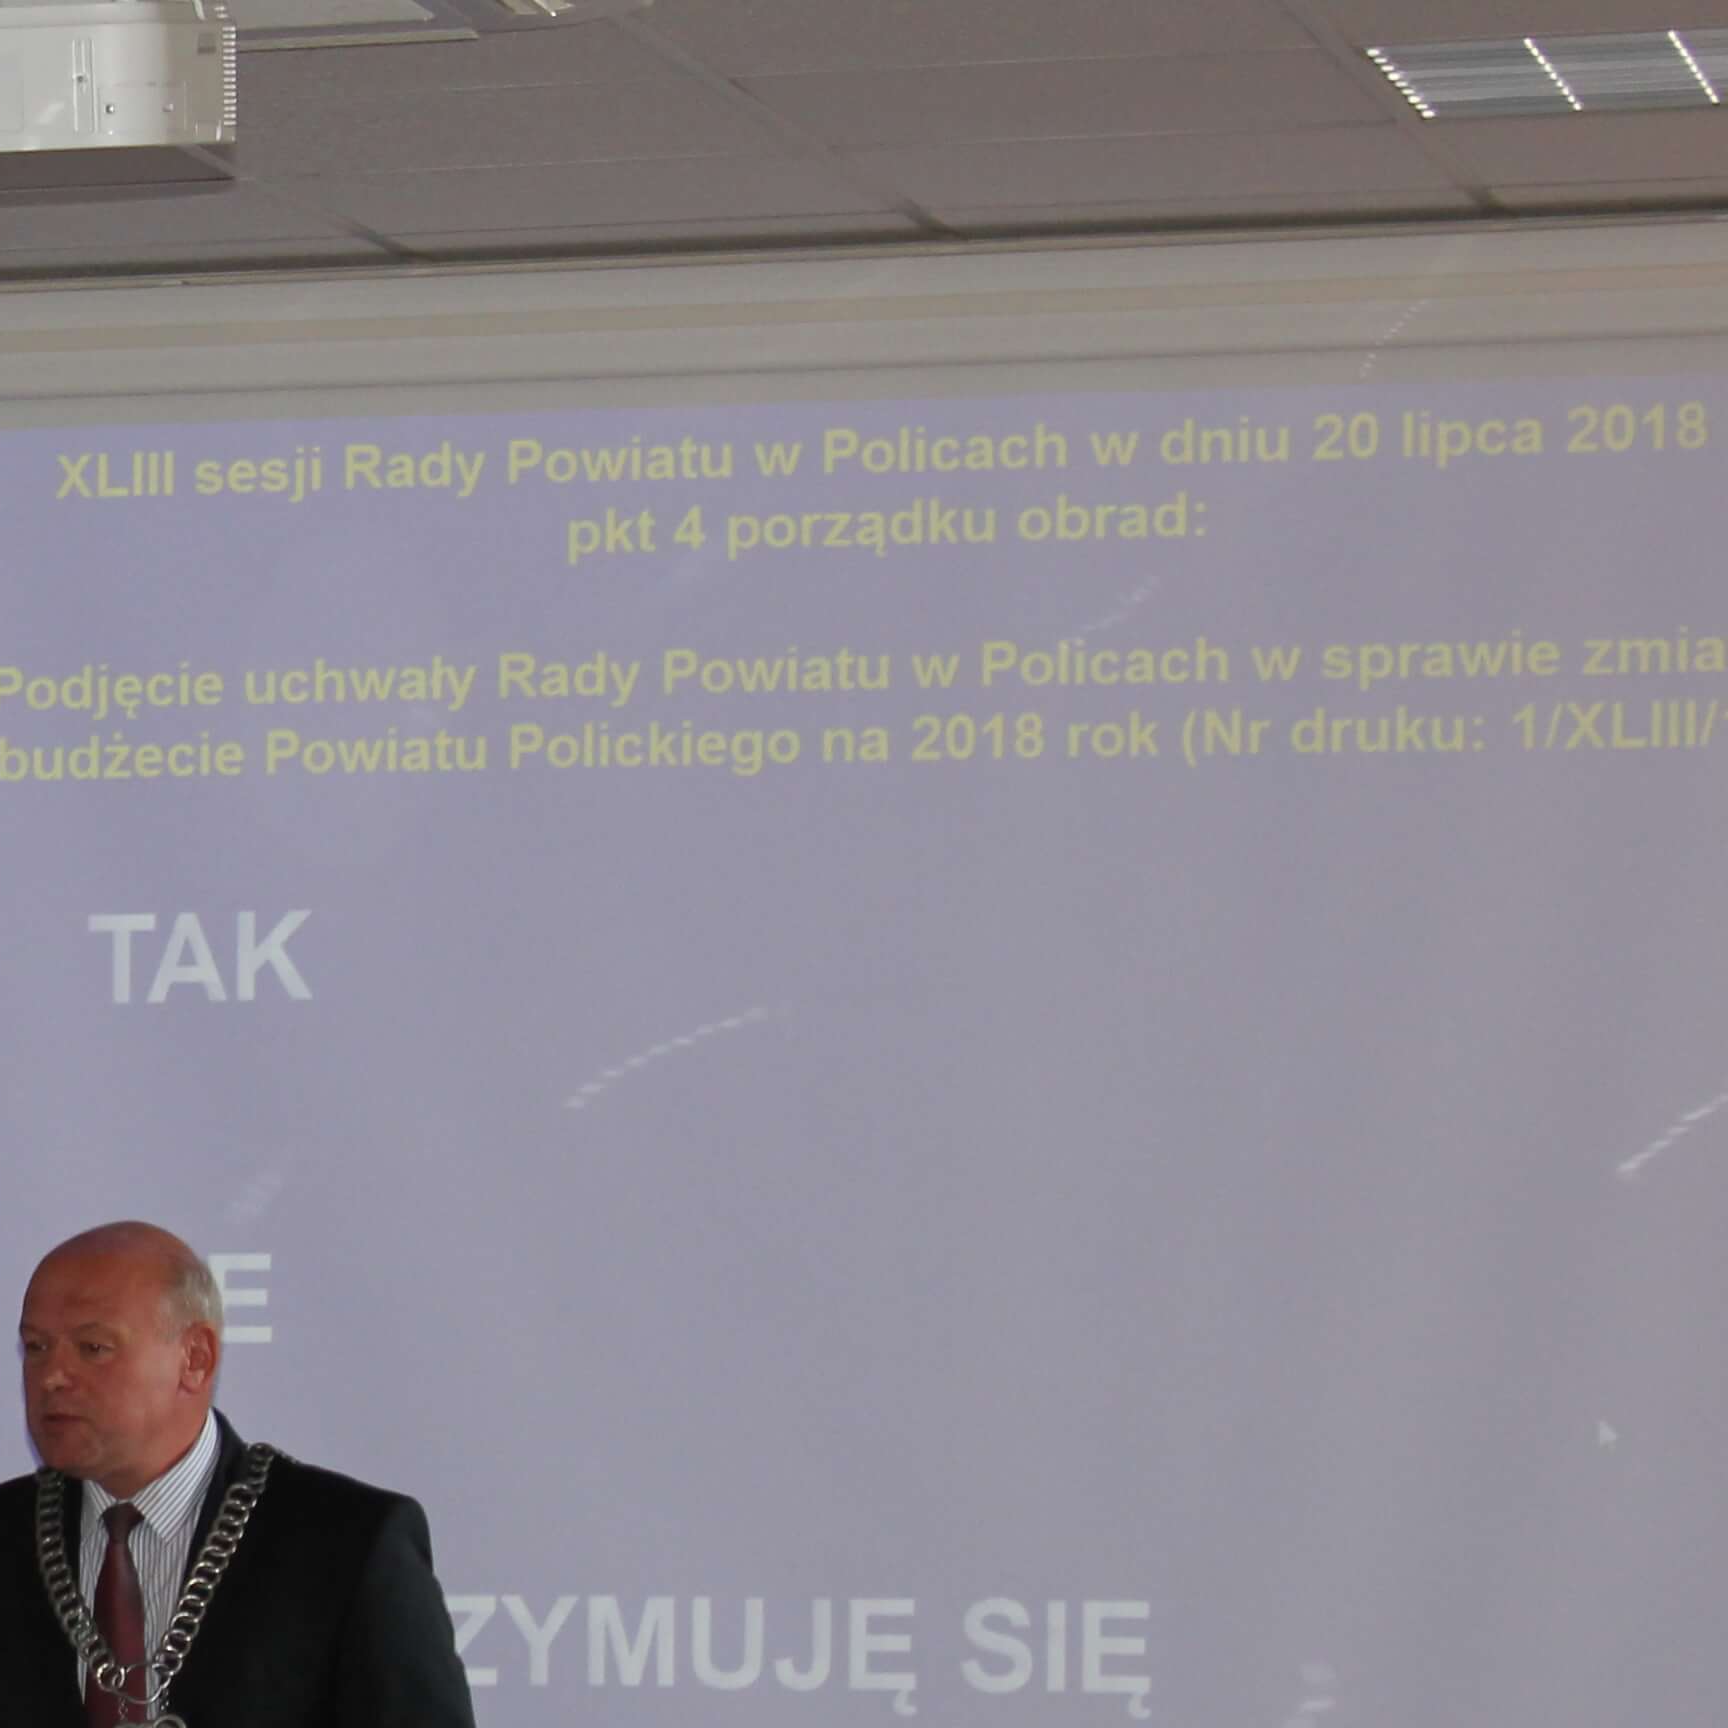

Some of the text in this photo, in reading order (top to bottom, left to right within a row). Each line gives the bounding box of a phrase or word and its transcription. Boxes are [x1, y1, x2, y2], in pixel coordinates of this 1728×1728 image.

[56, 399, 1710, 504] XLIII sesji Rady Powiatu w Policach w dniu 20 lipca 2018
[566, 490, 1209, 565] pkt 4 porządku obrad:
[244, 656, 479, 712] uchwały
[497, 651, 642, 707] Rady
[662, 646, 892, 695] Powiatu
[912, 653, 961, 689] w
[978, 635, 1232, 688] Policach
[1250, 643, 1304, 683] w
[1322, 628, 1564, 691] sprawie
[1582, 625, 1728, 678] zmia
[265, 724, 489, 776] Powiatu
[508, 719, 803, 777] Polickiego
[821, 726, 891, 763] na
[910, 711, 1047, 763] 2018
[1065, 709, 1160, 759] rok
[1180, 706, 1273, 769] (Nr
[1289, 704, 1487, 755] druku:
[1511, 697, 1728, 752] 1/XLIII/
[87, 908, 313, 1004] TAK
[444, 1594, 1152, 1720] ZYMUJĘ SIĘ
